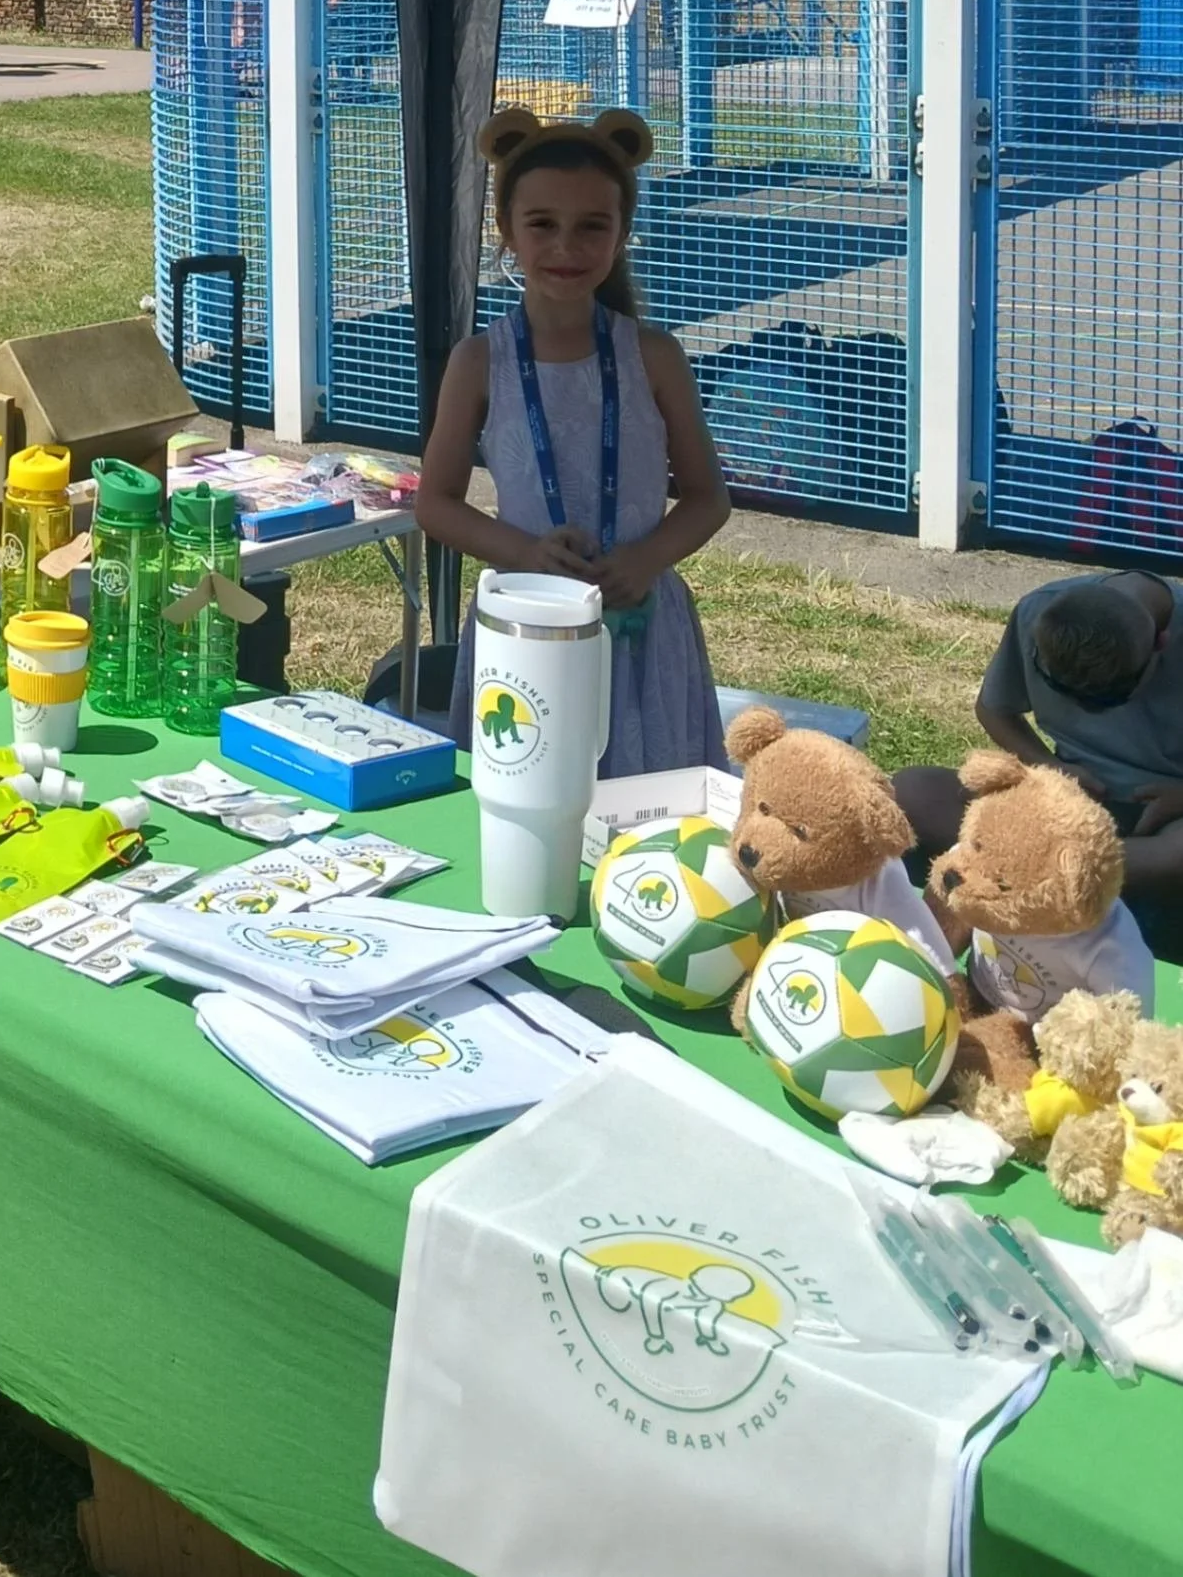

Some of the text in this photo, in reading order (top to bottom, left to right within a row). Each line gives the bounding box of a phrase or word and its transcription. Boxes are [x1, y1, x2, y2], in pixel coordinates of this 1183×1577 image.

[505, 671, 550, 717] FISHER
[459, 1037, 485, 1074] FISHER
[579, 1212, 834, 1305] OLIVER FISH
[533, 1252, 584, 1374] SPECIAL
[593, 1382, 652, 1435] CARE
[666, 1428, 728, 1451] BABY
[737, 1372, 798, 1440] TRUST
